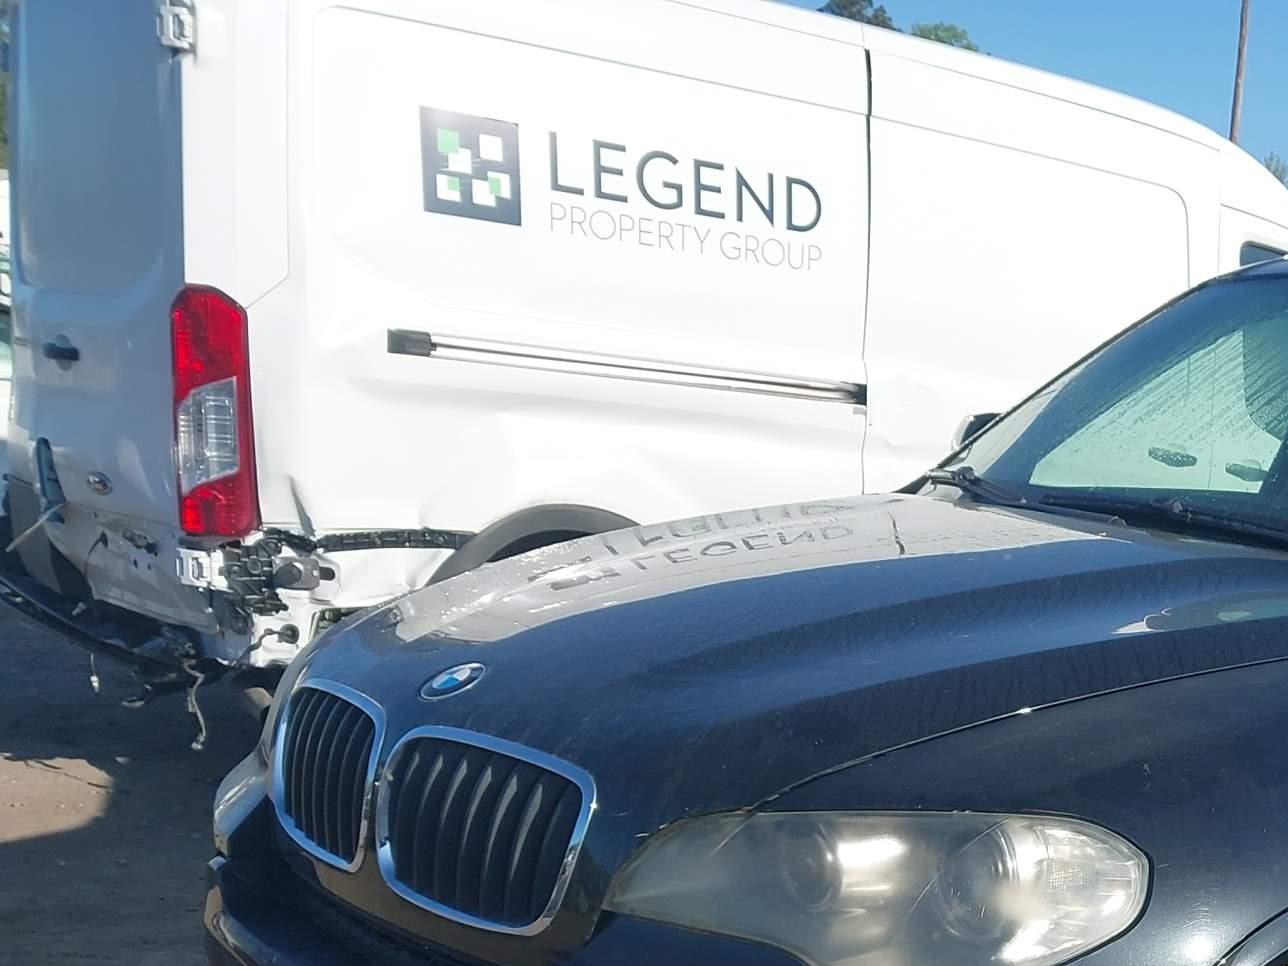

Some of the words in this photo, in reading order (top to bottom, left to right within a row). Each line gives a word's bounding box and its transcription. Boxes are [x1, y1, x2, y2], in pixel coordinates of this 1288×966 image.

[548, 130, 822, 233] LEGEND
[550, 202, 711, 255] PROPERTY
[719, 231, 822, 271] GROUP
